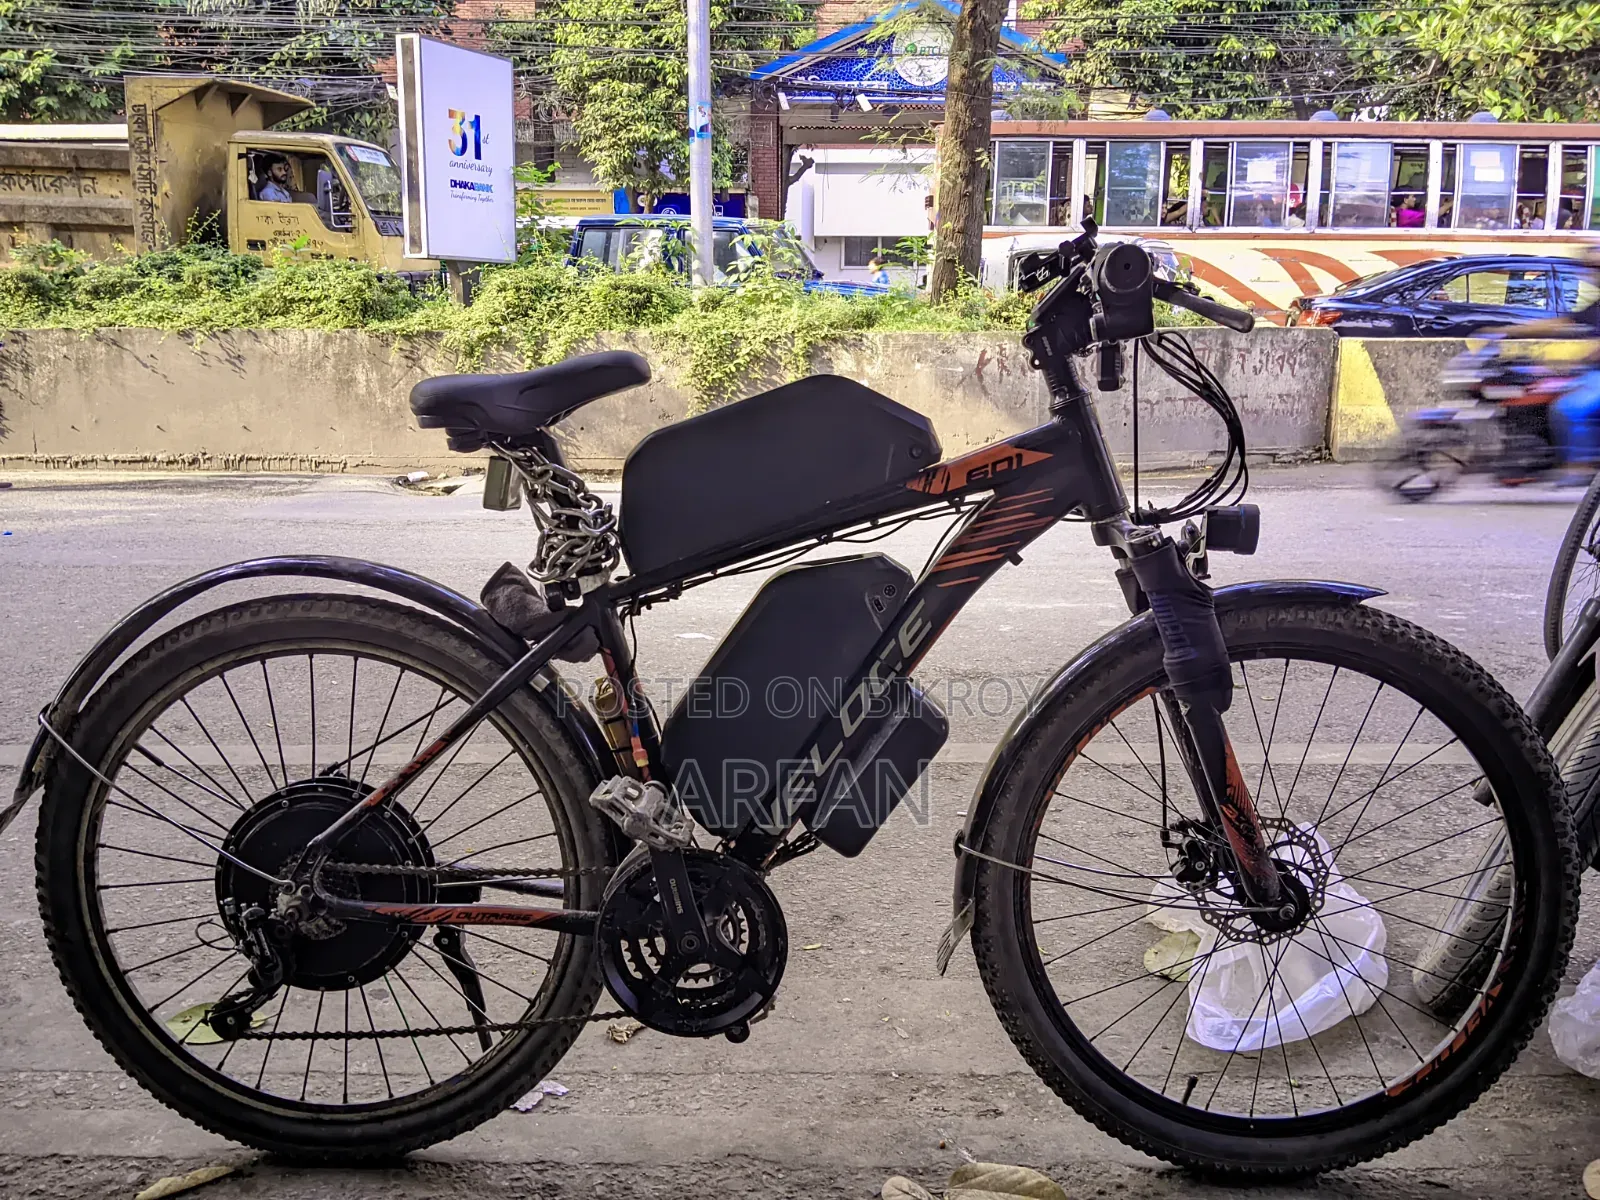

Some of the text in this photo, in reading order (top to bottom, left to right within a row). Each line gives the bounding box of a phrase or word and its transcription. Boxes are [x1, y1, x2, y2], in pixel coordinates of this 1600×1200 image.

[449, 159, 493, 177] anniversary
[966, 453, 1023, 484] 601
[752, 598, 932, 836] VELOCE
[456, 911, 533, 921] OUTRAGE
